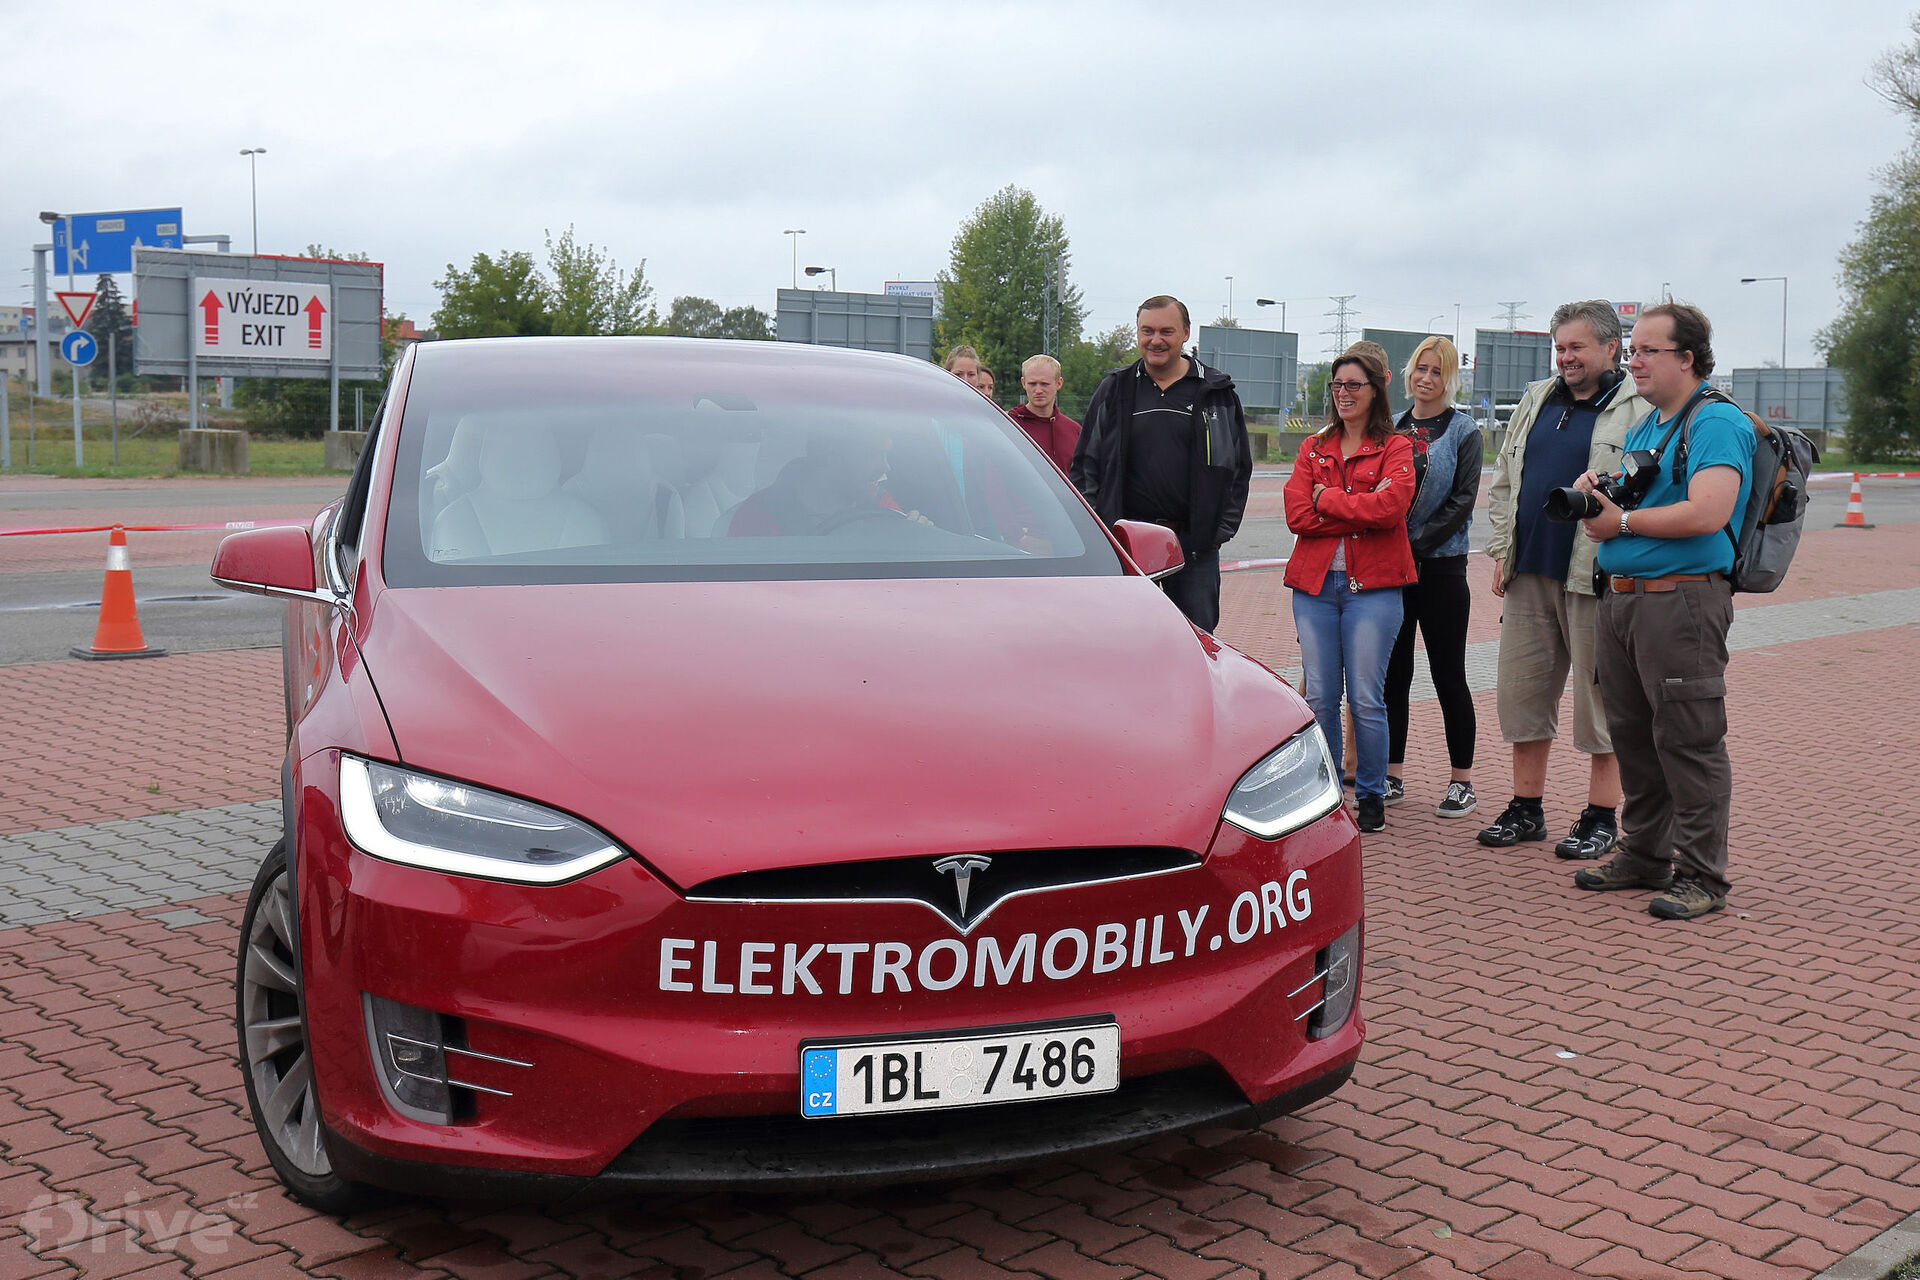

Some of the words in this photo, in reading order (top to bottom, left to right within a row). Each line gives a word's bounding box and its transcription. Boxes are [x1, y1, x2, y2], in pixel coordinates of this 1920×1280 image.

[227, 287, 299, 316] VÝJEZD
[242, 324, 285, 346] EXIT
[658, 870, 1312, 996] ELEKTROMOBILY.ORG
[853, 1051, 940, 1104] 1BL
[982, 1036, 1096, 1096] 7486
[809, 1092, 832, 1108] CZ
